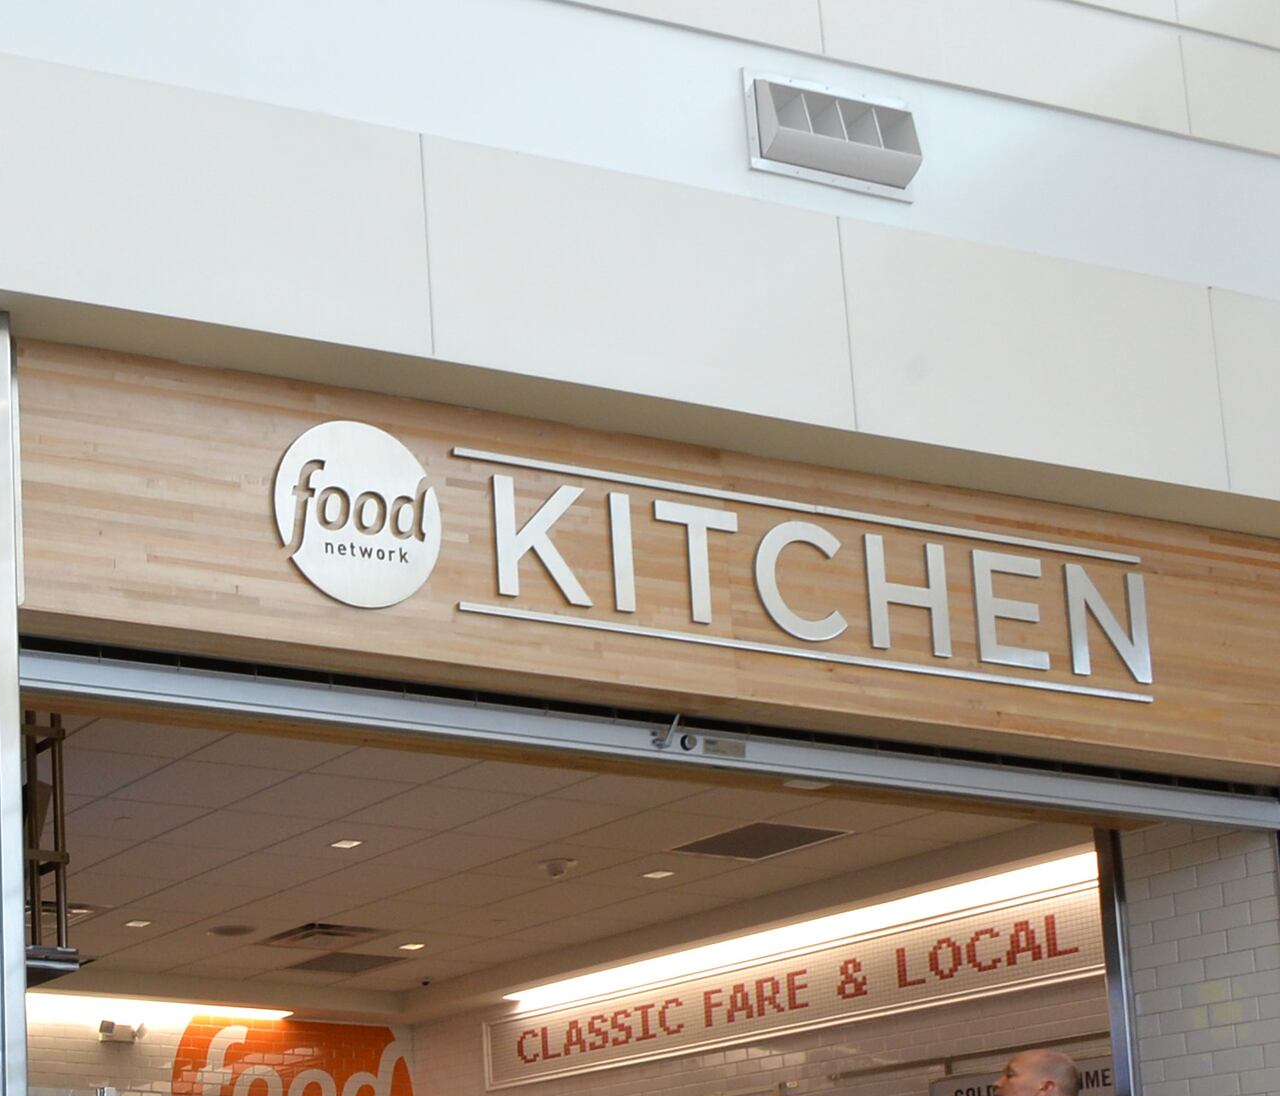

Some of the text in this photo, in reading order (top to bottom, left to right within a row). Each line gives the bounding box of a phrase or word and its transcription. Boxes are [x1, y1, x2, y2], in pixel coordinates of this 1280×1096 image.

[285, 458, 433, 557] food
[324, 540, 409, 564] network
[493, 474, 1153, 684] KITCHEN
[516, 914, 1080, 1064] CLASSIC FARE & LOCAL
[1079, 1068, 1112, 1090] IME
